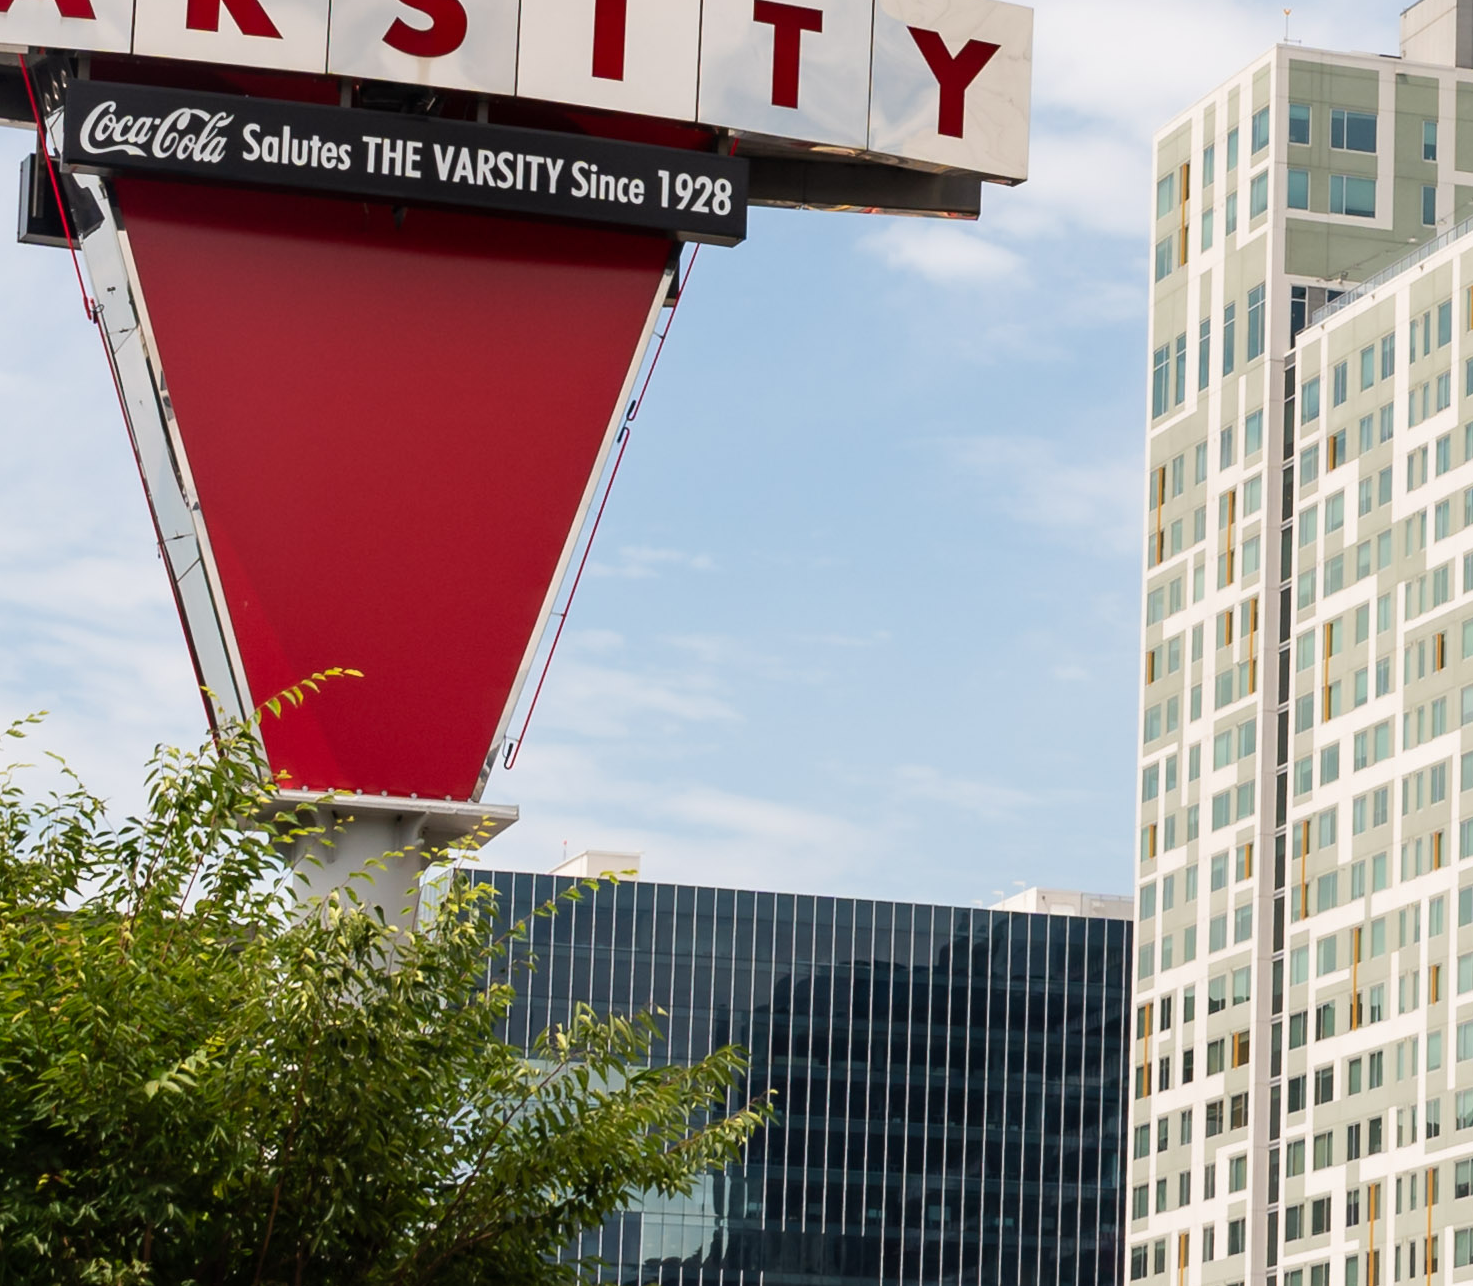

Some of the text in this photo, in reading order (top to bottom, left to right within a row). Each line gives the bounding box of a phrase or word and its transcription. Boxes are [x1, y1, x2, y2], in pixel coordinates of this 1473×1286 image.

[79, 101, 733, 215] Coca-Cola Salutes THE VARSITY Since 1928
